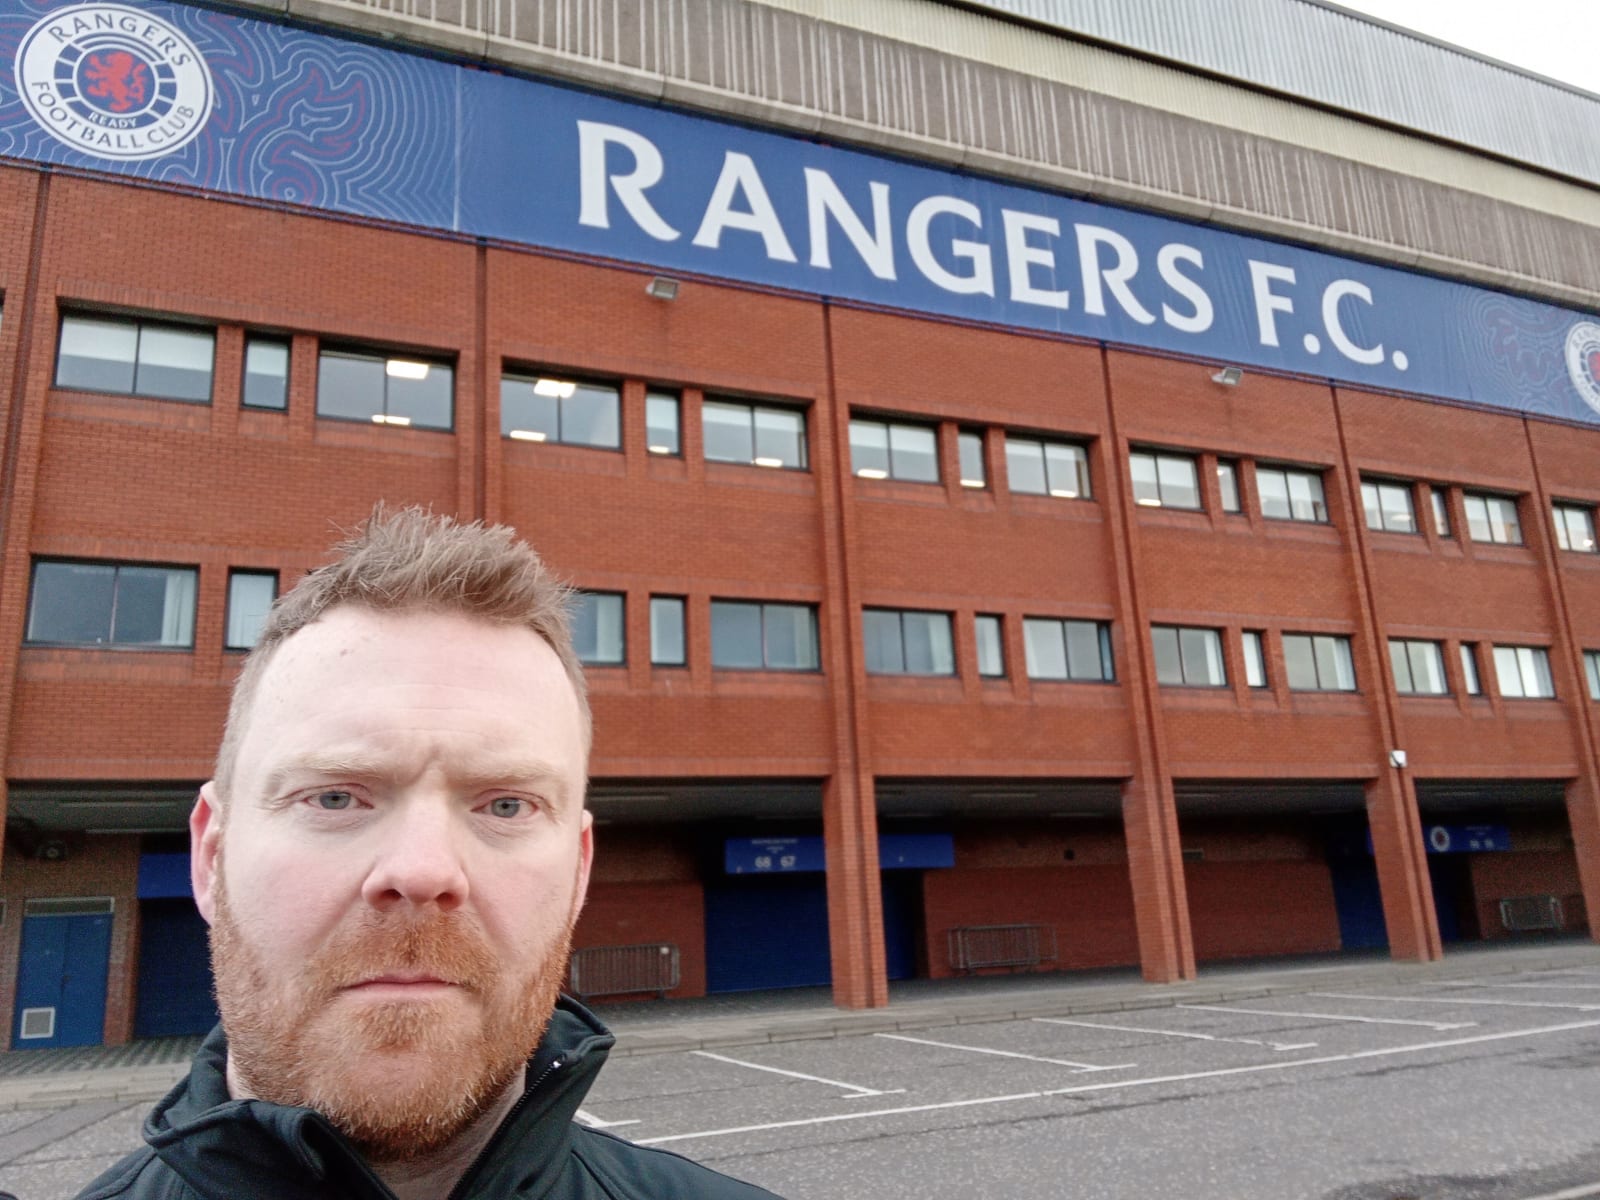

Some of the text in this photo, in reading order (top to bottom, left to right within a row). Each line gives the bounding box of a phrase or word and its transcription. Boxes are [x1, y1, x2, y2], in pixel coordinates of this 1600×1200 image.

[48, 13, 192, 68] RANGERS
[32, 80, 195, 149] FOOTBALL CLUB
[88, 111, 138, 129] READY
[577, 119, 1409, 371] RANGERS F.C.
